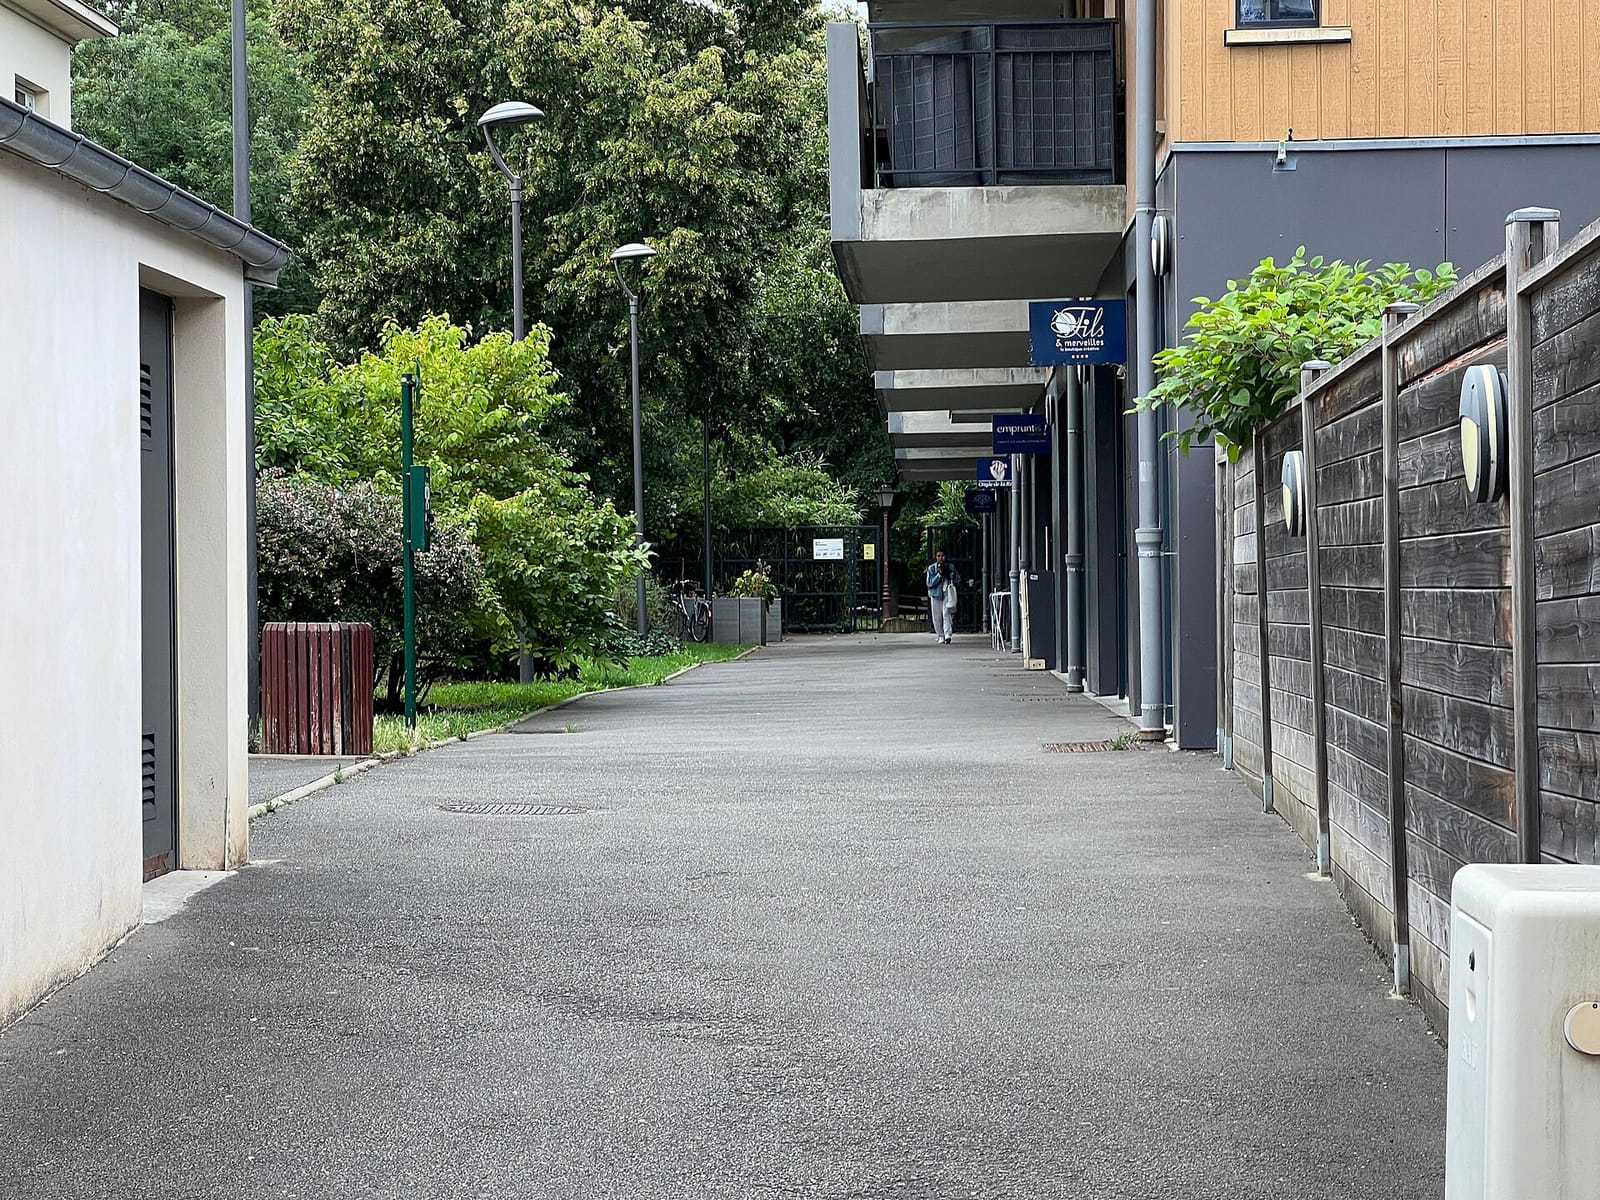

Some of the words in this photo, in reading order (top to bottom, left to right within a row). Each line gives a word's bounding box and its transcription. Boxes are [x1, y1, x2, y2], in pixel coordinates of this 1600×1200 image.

[1055, 338, 1062, 347] &
[1064, 338, 1104, 347] merveilles
[997, 424, 1041, 436] empruntis
